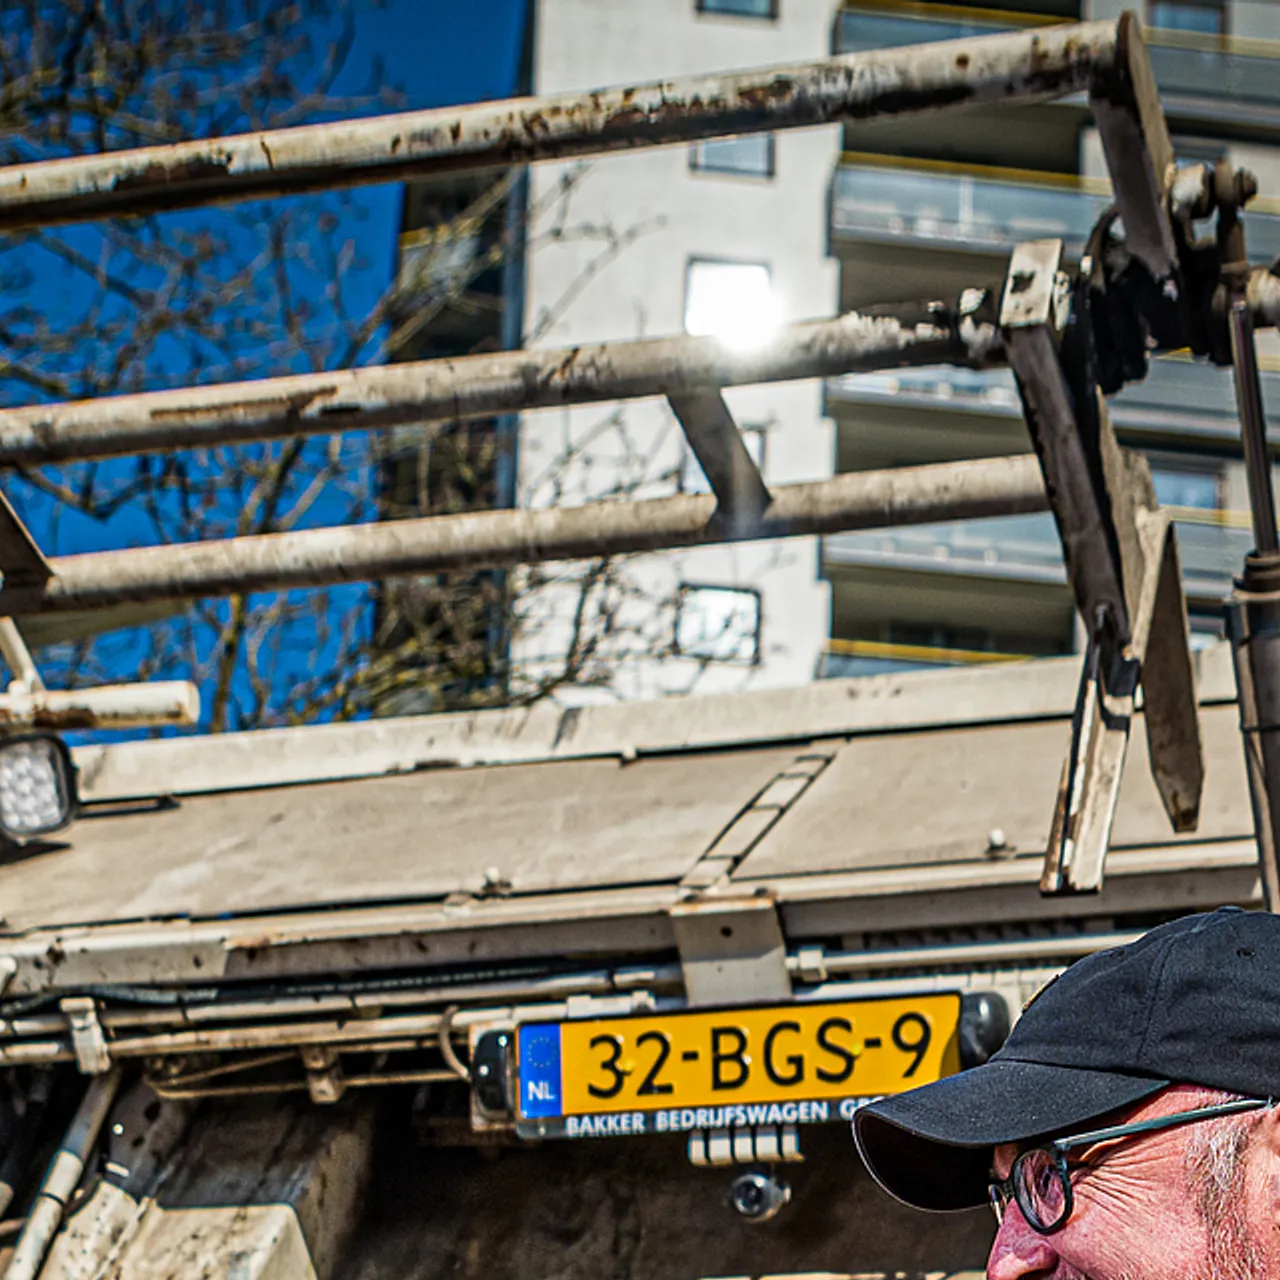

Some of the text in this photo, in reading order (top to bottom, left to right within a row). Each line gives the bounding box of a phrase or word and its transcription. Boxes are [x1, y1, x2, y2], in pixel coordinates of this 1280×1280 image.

[587, 1011, 933, 1099] 32-BGS-9
[527, 1080, 556, 1101] NL
[566, 1112, 645, 1137] BAKKER
[655, 1101, 829, 1131] BEDRIJFSWAGEN
